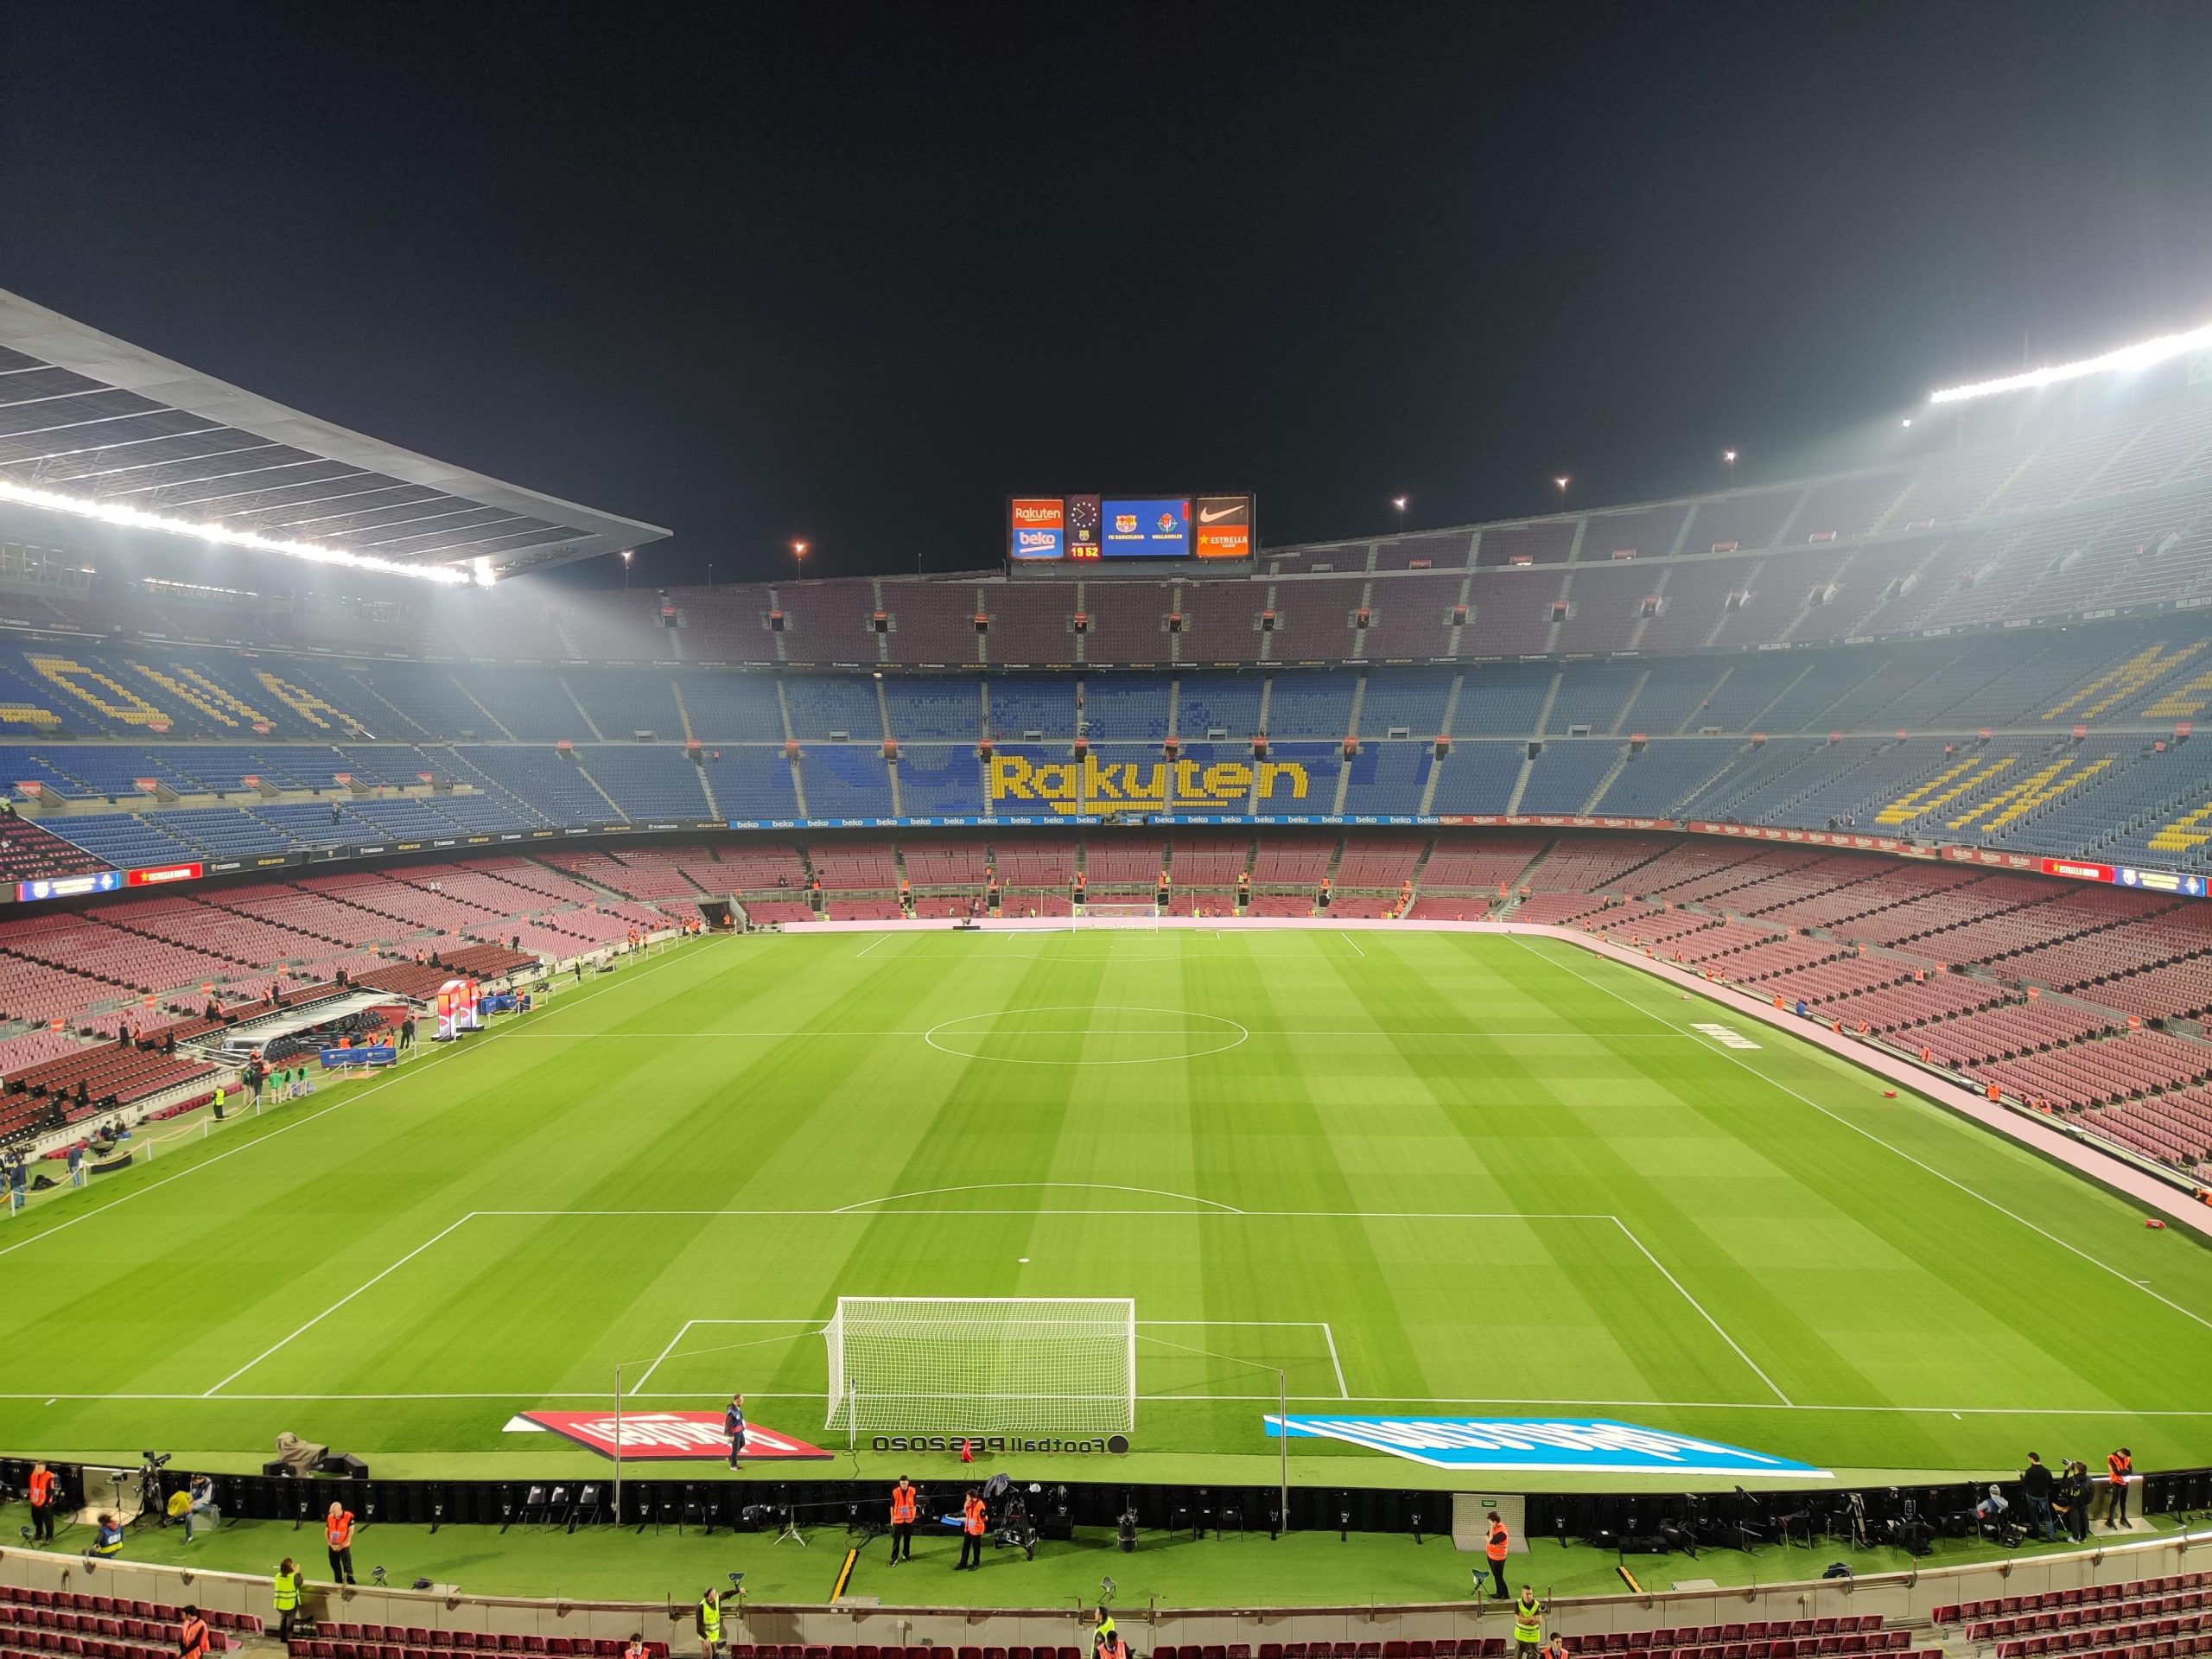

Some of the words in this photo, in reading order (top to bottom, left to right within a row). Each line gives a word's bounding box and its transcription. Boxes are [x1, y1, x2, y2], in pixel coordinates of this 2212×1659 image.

[1015, 508, 1060, 521] Rakuten
[1020, 532, 1055, 544] beko
[991, 755, 1308, 805] Rakuten
